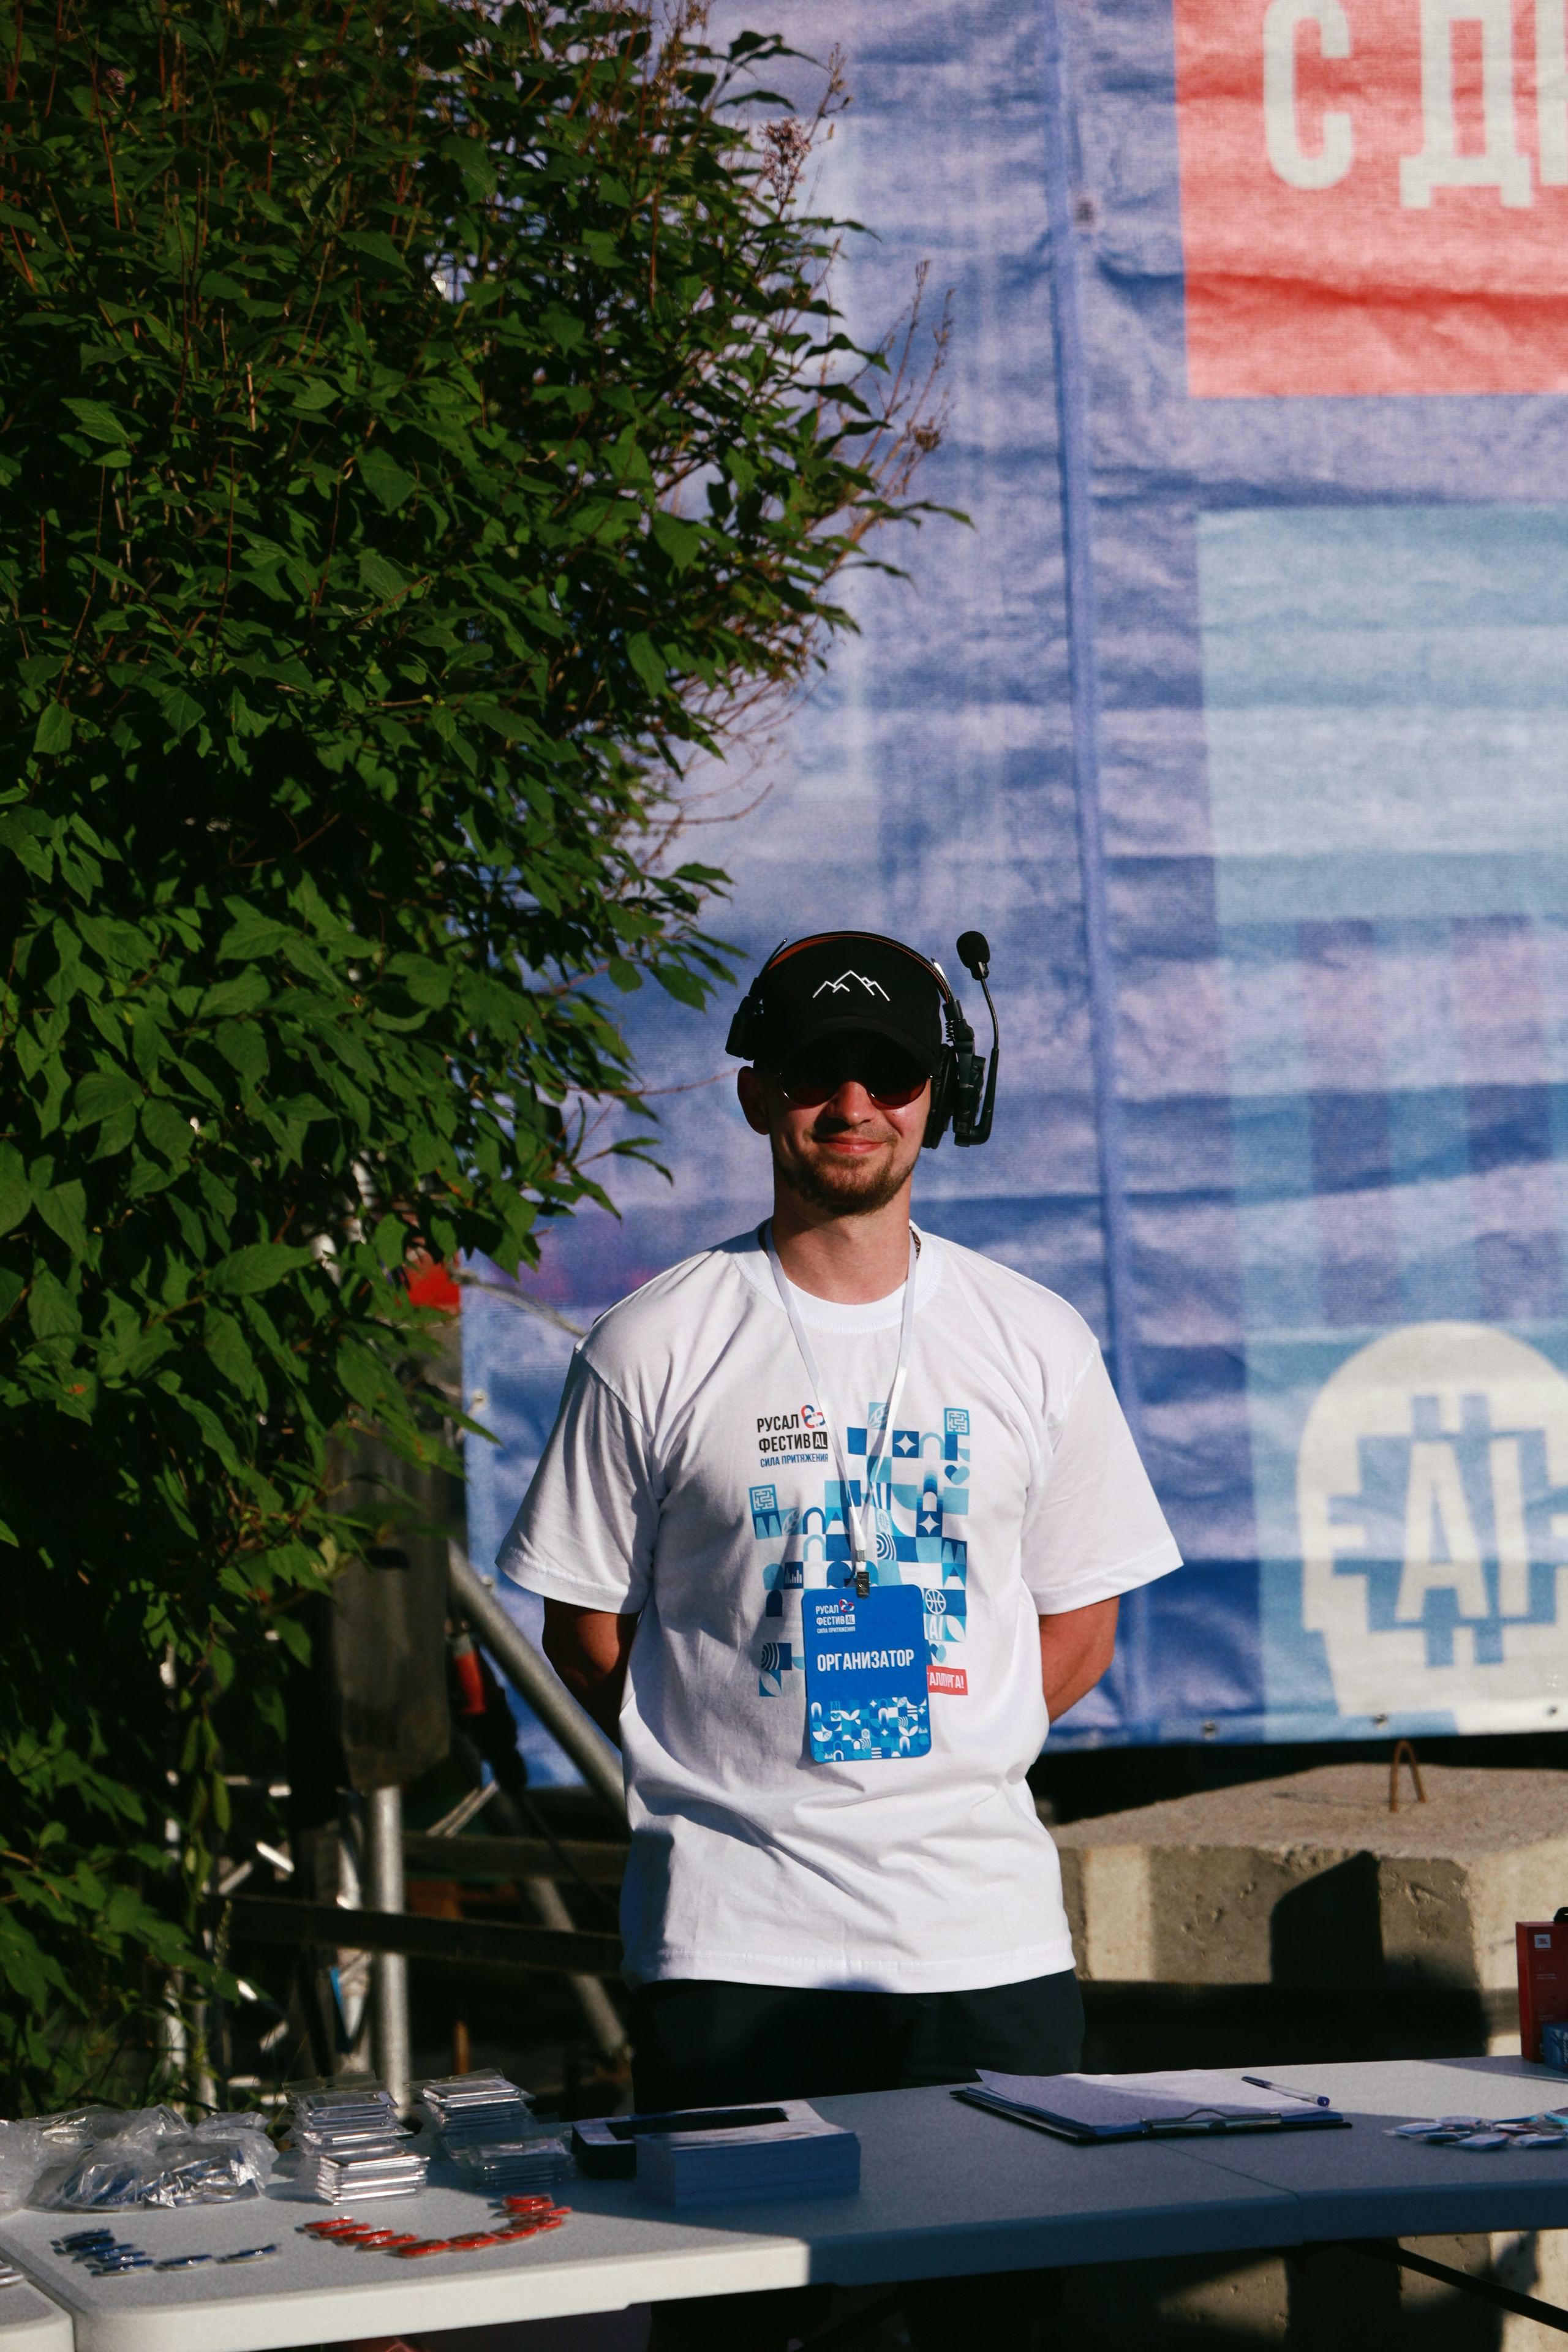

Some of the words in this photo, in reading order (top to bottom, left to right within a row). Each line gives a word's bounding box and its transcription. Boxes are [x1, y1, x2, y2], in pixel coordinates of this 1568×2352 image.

[757, 1414, 799, 1433] РУСАЛ
[760, 1457, 780, 1468] СИЛА
[781, 1453, 829, 1464] ПРИТЯЖЕНИЯ
[815, 1604, 839, 1615] РУСАЛ
[817, 1649, 914, 1672] ОРГАНИЗАТОР
[927, 1672, 965, 1689] АЛЛУРГА!
